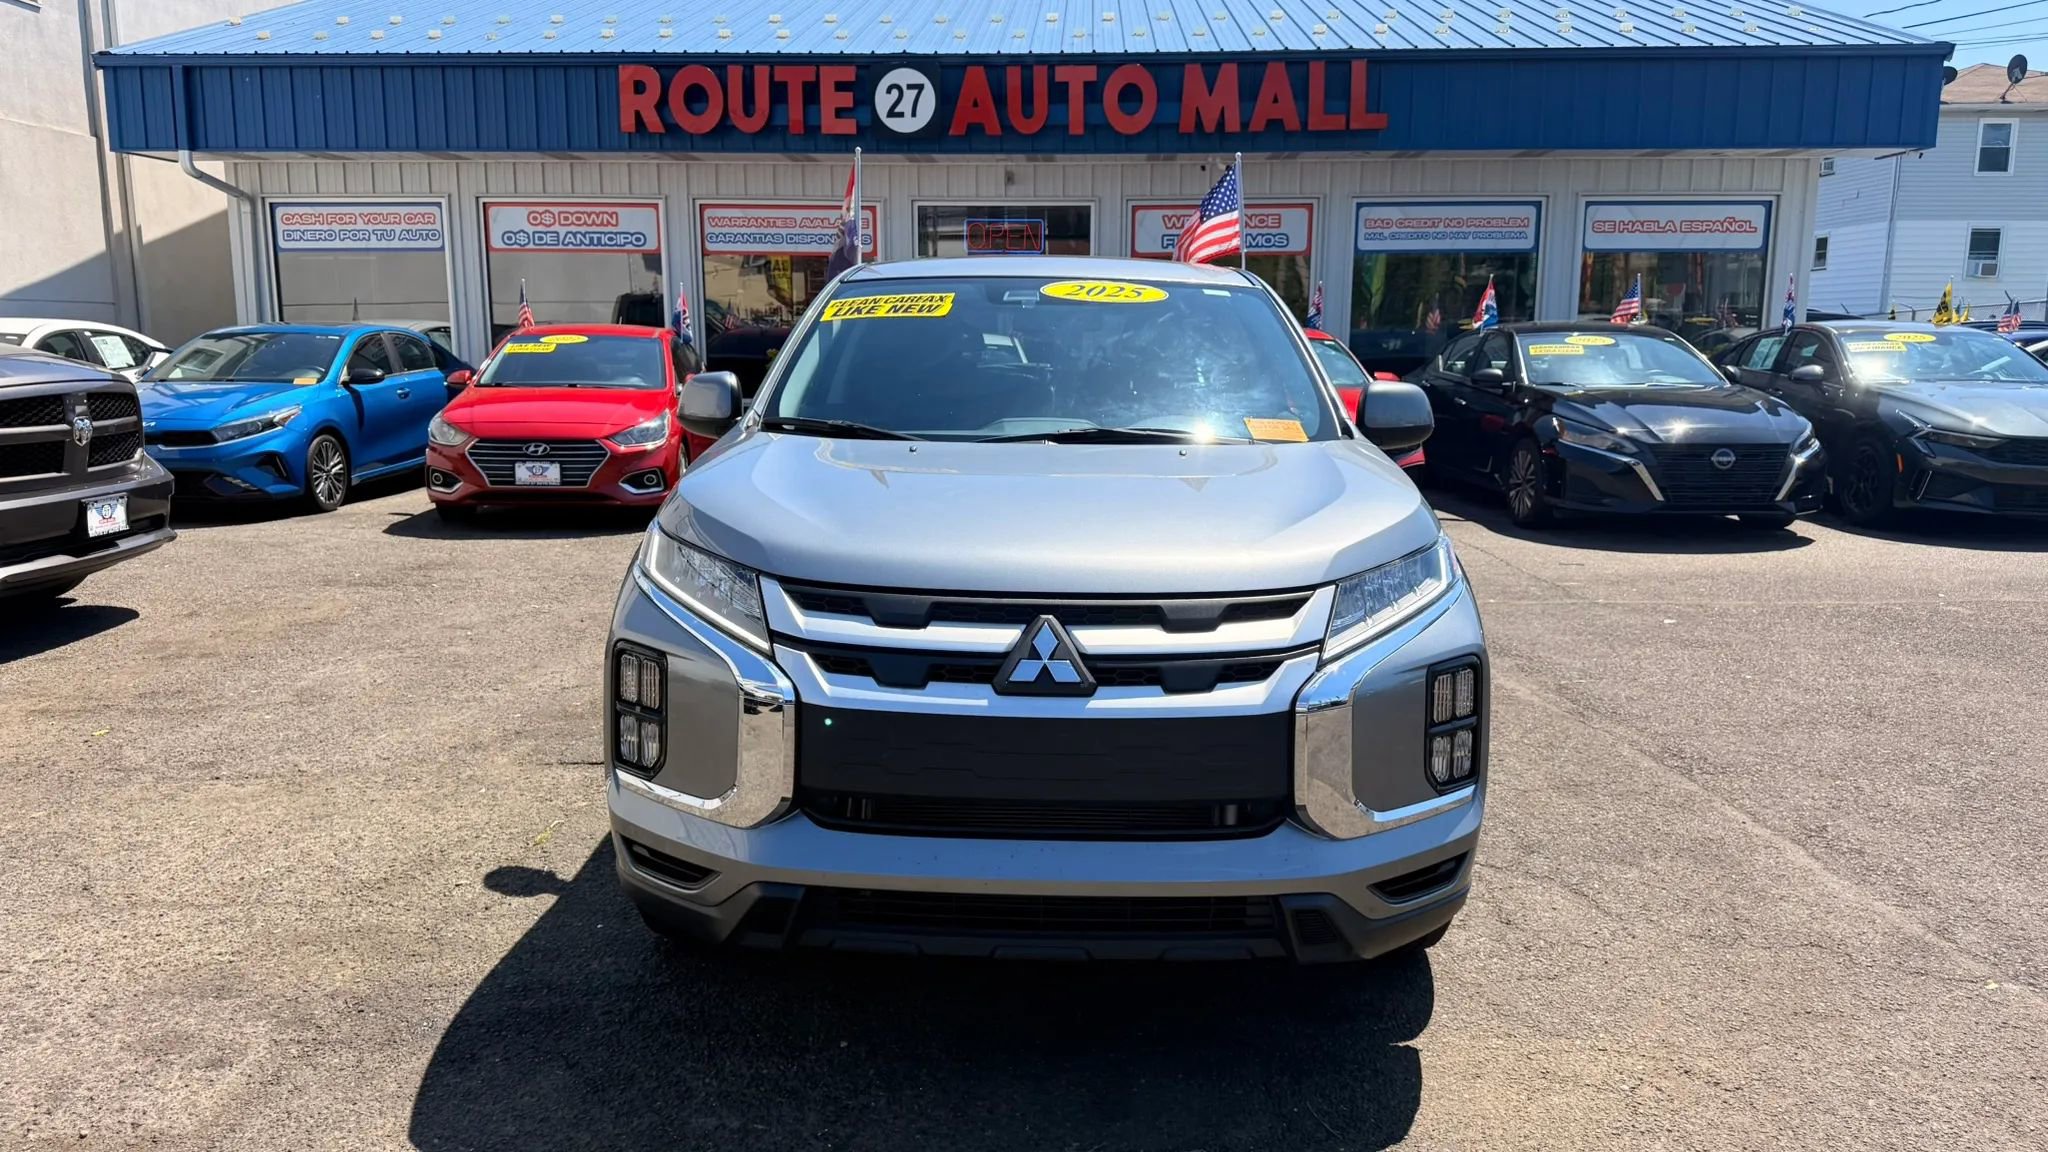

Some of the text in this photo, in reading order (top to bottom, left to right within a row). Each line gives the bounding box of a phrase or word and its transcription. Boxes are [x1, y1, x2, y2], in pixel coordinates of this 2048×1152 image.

[618, 59, 1389, 135] ROUTE 27 AUTO MALL
[281, 213, 436, 225] CASH FOR YOUR CAR
[558, 211, 618, 227] DOWN
[708, 216, 870, 229] WARRANTIES AVAILAE
[1365, 217, 1529, 229] BAD CREDIT NO PROBLEM
[1592, 217, 1757, 233] SE HABLA ESPAÑOL
[283, 229, 441, 242] DINERO POR TU AUTO
[533, 231, 559, 246] DE
[561, 231, 646, 247] ANTICIPO
[706, 232, 784, 244] GARANTIAS
[968, 222, 1041, 250] OPEN
[1364, 231, 1387, 241] MAL
[1389, 231, 1430, 240] CREDITO
[1432, 231, 1449, 240] NO
[1472, 231, 1528, 240] PROBLEMA
[1065, 285, 1148, 298] 2025
[884, 295, 947, 304] CARFAX
[831, 303, 946, 318] LIKE NEW
